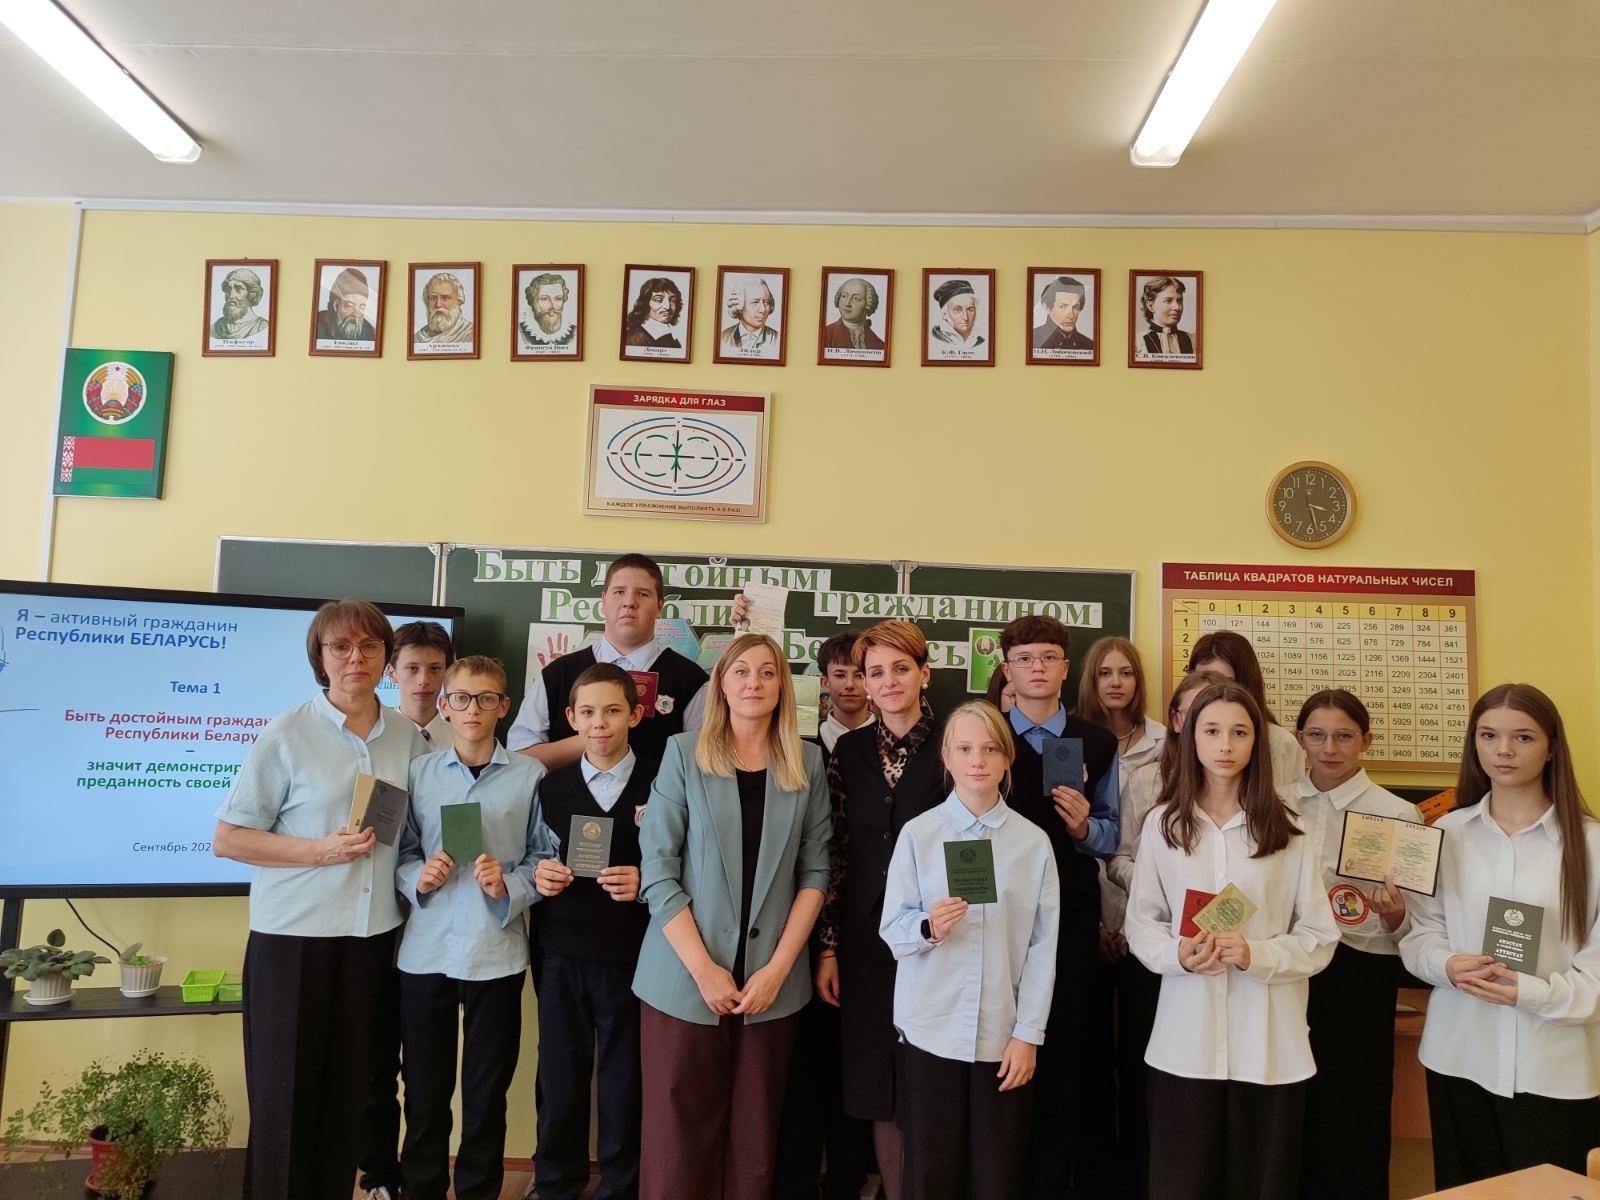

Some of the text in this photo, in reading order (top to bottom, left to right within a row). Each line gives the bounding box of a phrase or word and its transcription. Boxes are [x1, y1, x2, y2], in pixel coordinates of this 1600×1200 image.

[634, 395, 726, 406] ЗАРЯДКА ДЛЯ ГЛАЗ
[1292, 477, 1299, 488] 11
[1306, 474, 1316, 485] 12
[1283, 488, 1294, 498] 10
[1329, 487, 1336, 498] 2
[1279, 501, 1286, 511] 9
[1333, 501, 1340, 512] 3
[1284, 513, 1291, 524] 8
[1328, 514, 1335, 523] 4
[1295, 521, 1302, 532] 7
[1306, 524, 1314, 534] 6
[1320, 521, 1327, 532] 5
[478, 550, 819, 591] Быть дтойным
[1184, 571, 1453, 586] ТАБЛИЦА КВАДРАТОВ НАТУРАЛЬНЫХ ЧИСЕЛ
[546, 590, 746, 627] Ресбли
[820, 592, 1092, 624] гражданином
[1209, 603, 1455, 618] 0 1 2 3 4 5 6 7 8 9
[17, 608, 29, 622] Я
[50, 612, 137, 628] активный
[144, 617, 238, 633] гражданин
[1184, 618, 1188, 627] 1
[16, 626, 226, 649] Республики БЕЛАРУСЬ!
[1183, 634, 1189, 642] 2
[783, 630, 966, 667] Бесь
[1182, 650, 1189, 658] 3
[170, 680, 221, 694] Тема 1
[65, 710, 272, 728] Быть достойным граждан
[106, 727, 259, 744] Республики Белару
[86, 761, 242, 775] значит демонстрир
[77, 776, 230, 790] преданность своей
[133, 842, 211, 854] Сентябрь 202
